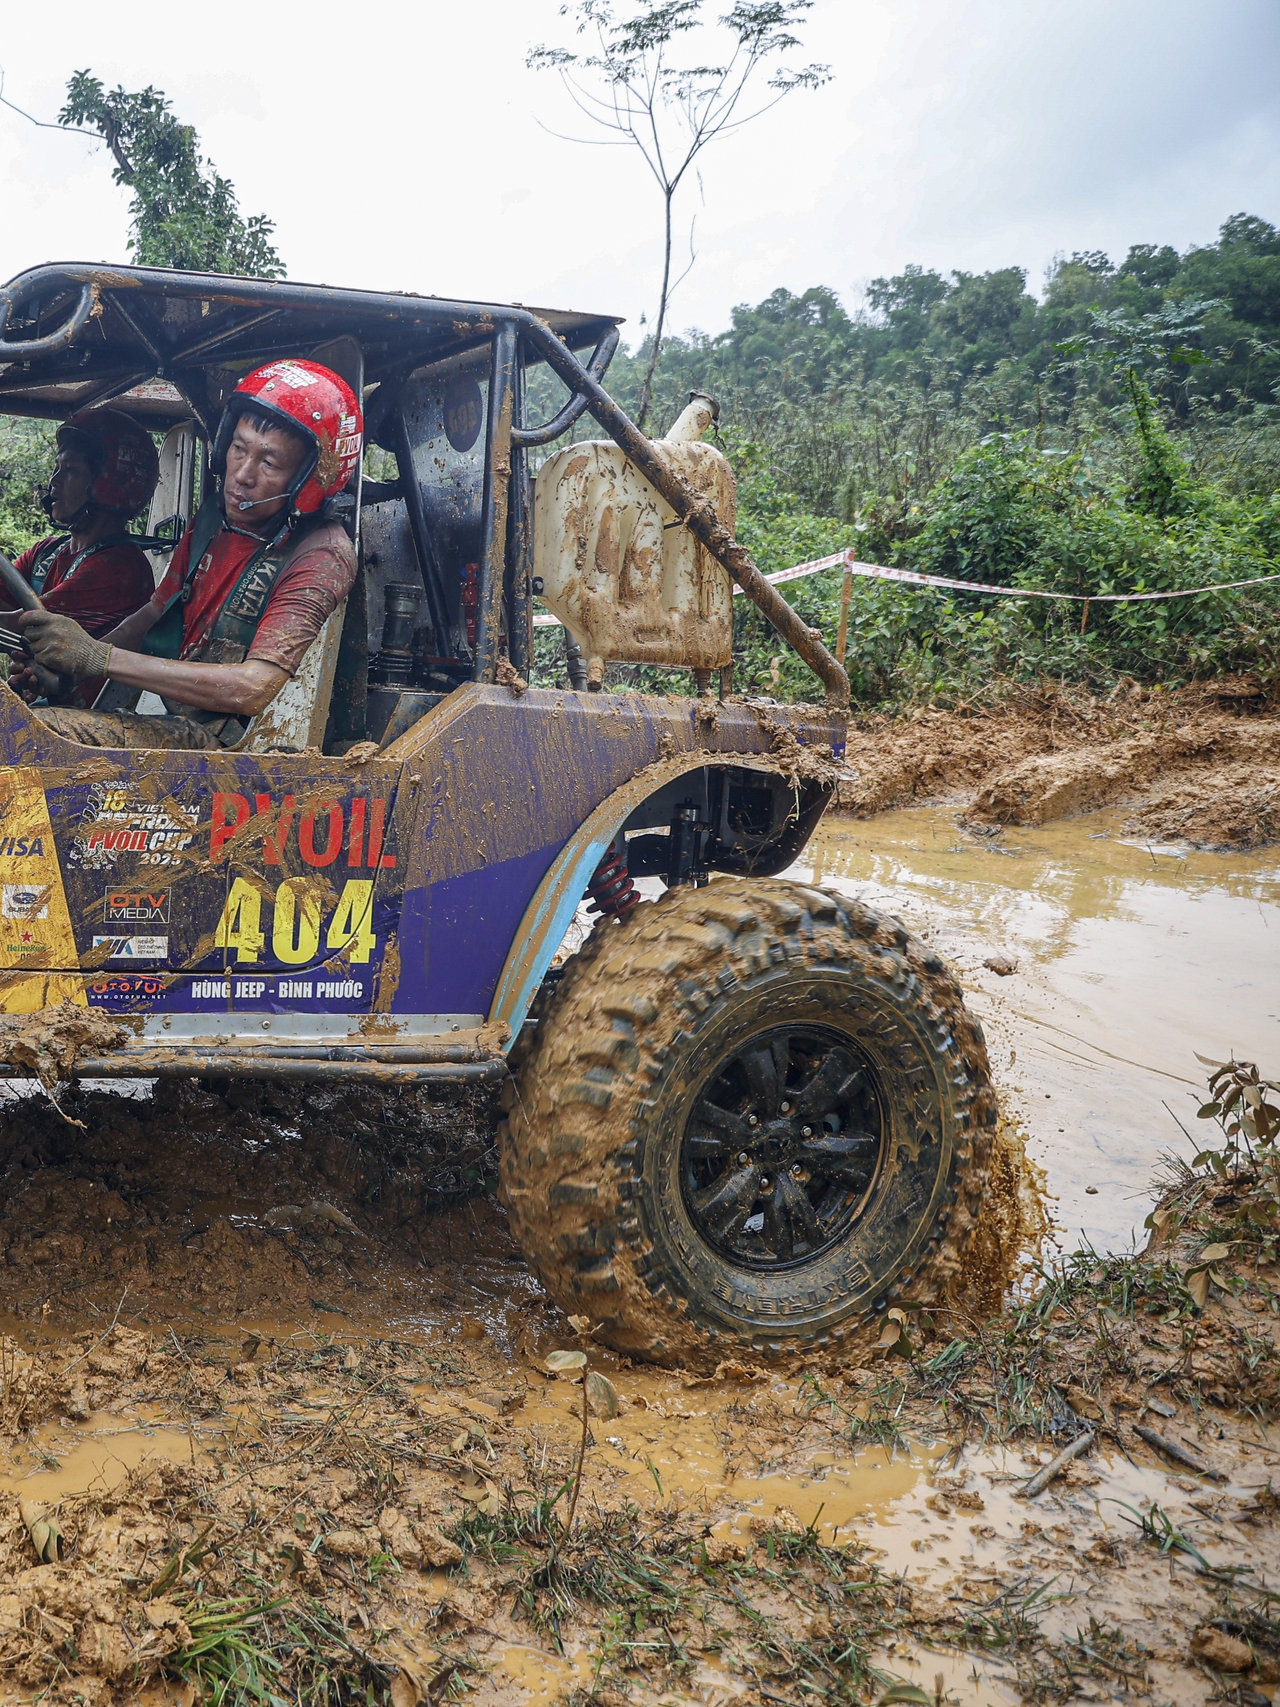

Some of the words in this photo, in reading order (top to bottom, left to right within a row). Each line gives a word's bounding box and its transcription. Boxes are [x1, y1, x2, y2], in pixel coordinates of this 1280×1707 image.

[89, 830, 149, 852] PVOIL
[209, 792, 397, 868] PVOIL
[110, 893, 166, 908] OTV
[109, 907, 166, 923] MEDIA
[214, 876, 377, 965] 404
[191, 980, 231, 998] HÙNG
[235, 982, 265, 998] JEEP
[279, 980, 313, 998] BÌNH
[316, 979, 363, 998] PHƯỚC
[711, 1260, 870, 1316] EXTREME
